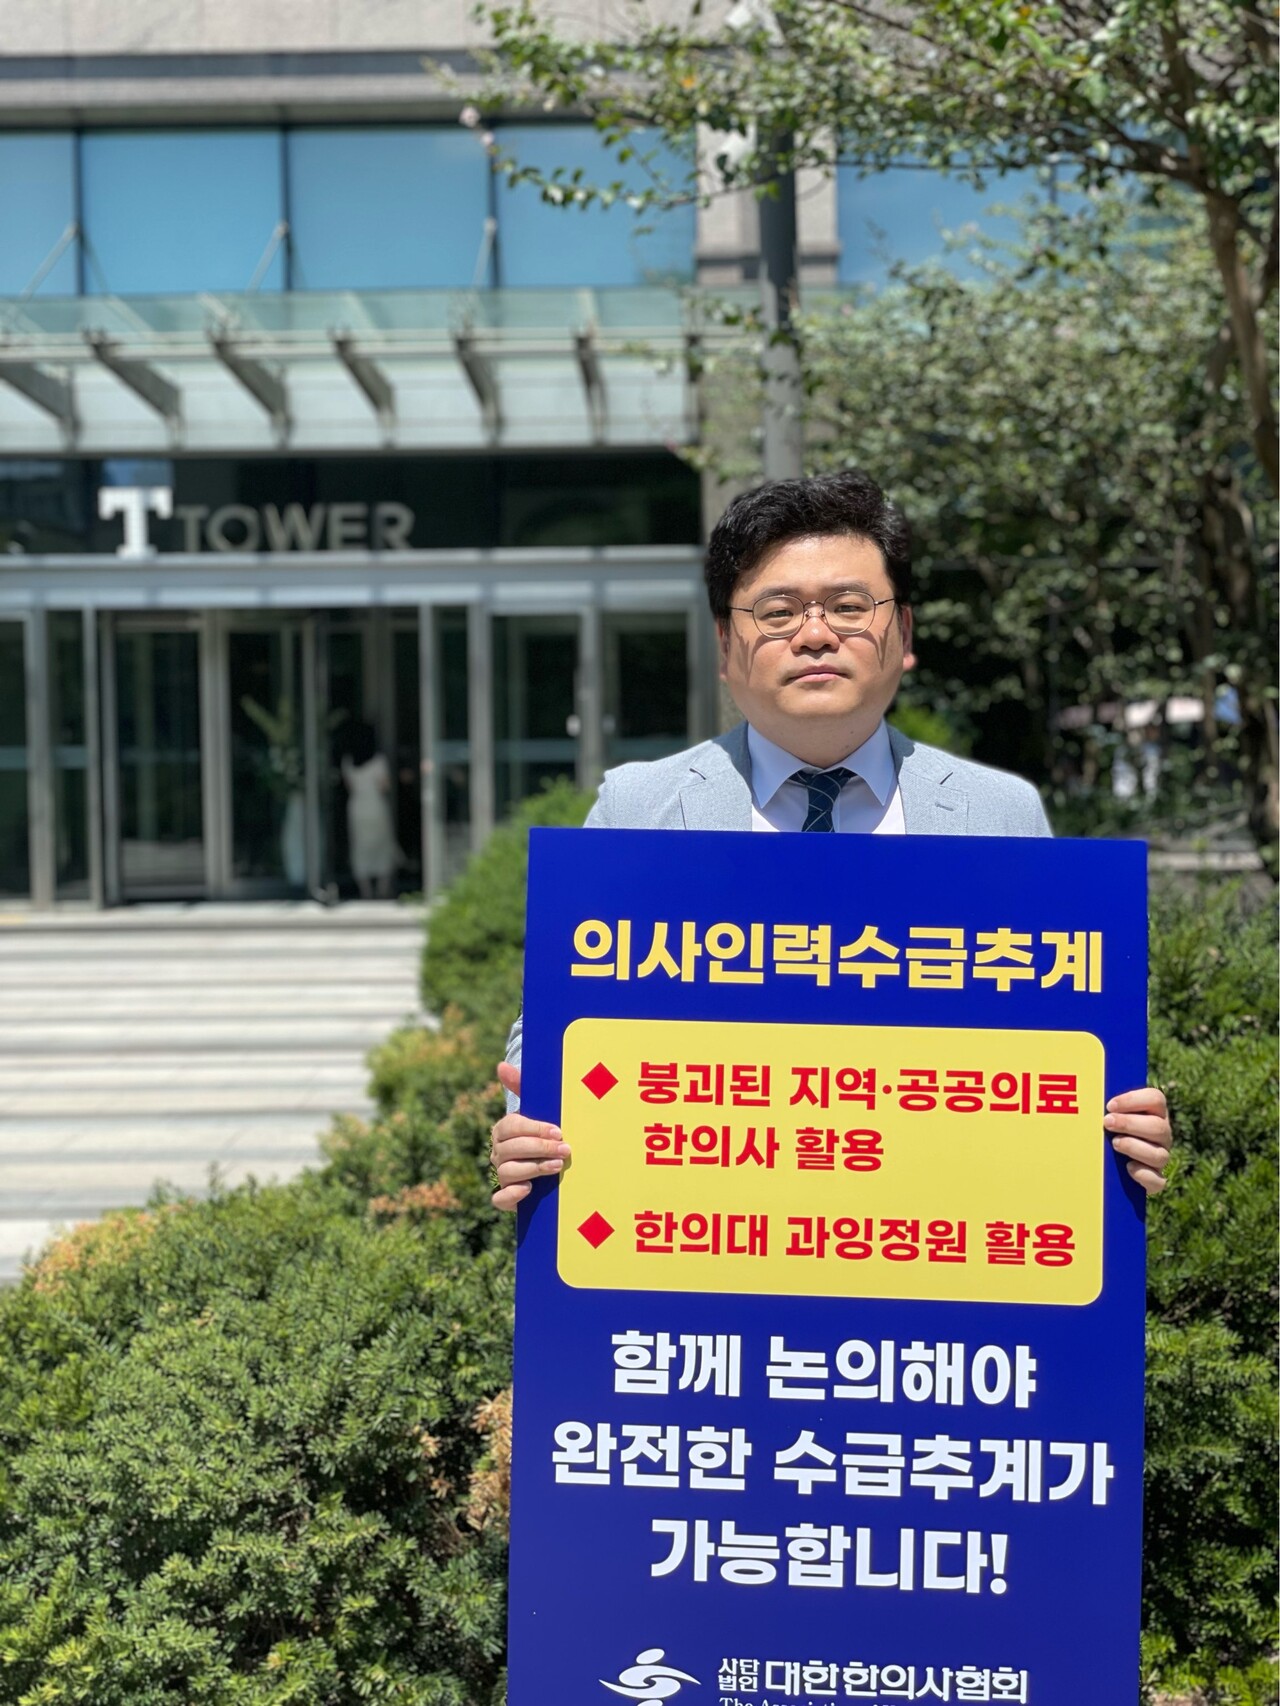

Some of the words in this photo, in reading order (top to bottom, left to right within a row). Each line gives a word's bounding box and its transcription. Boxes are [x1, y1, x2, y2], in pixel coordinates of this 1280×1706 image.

[98, 487, 173, 560] T
[174, 503, 415, 552] TOWER
[570, 919, 1103, 993] 의사인력수급추계
[637, 1061, 772, 1107] 붕괴된
[788, 1066, 1080, 1115] 지역·공공의료
[643, 1123, 780, 1169] 한의사
[795, 1126, 885, 1172] 활용
[633, 1210, 769, 1257] 한의대
[785, 1216, 968, 1263] 과잉정원
[984, 1221, 1076, 1267] 활용
[611, 1329, 742, 1398] 함께
[765, 1335, 1037, 1409] 논의해야
[551, 1420, 753, 1491] 완전한
[773, 1429, 1115, 1506] 수급추계가
[650, 1519, 1009, 1595] 가능합니다!
[718, 1657, 760, 1675] 사단
[718, 1675, 758, 1692] 법인
[765, 1659, 1028, 1704] 대한한의사협회
